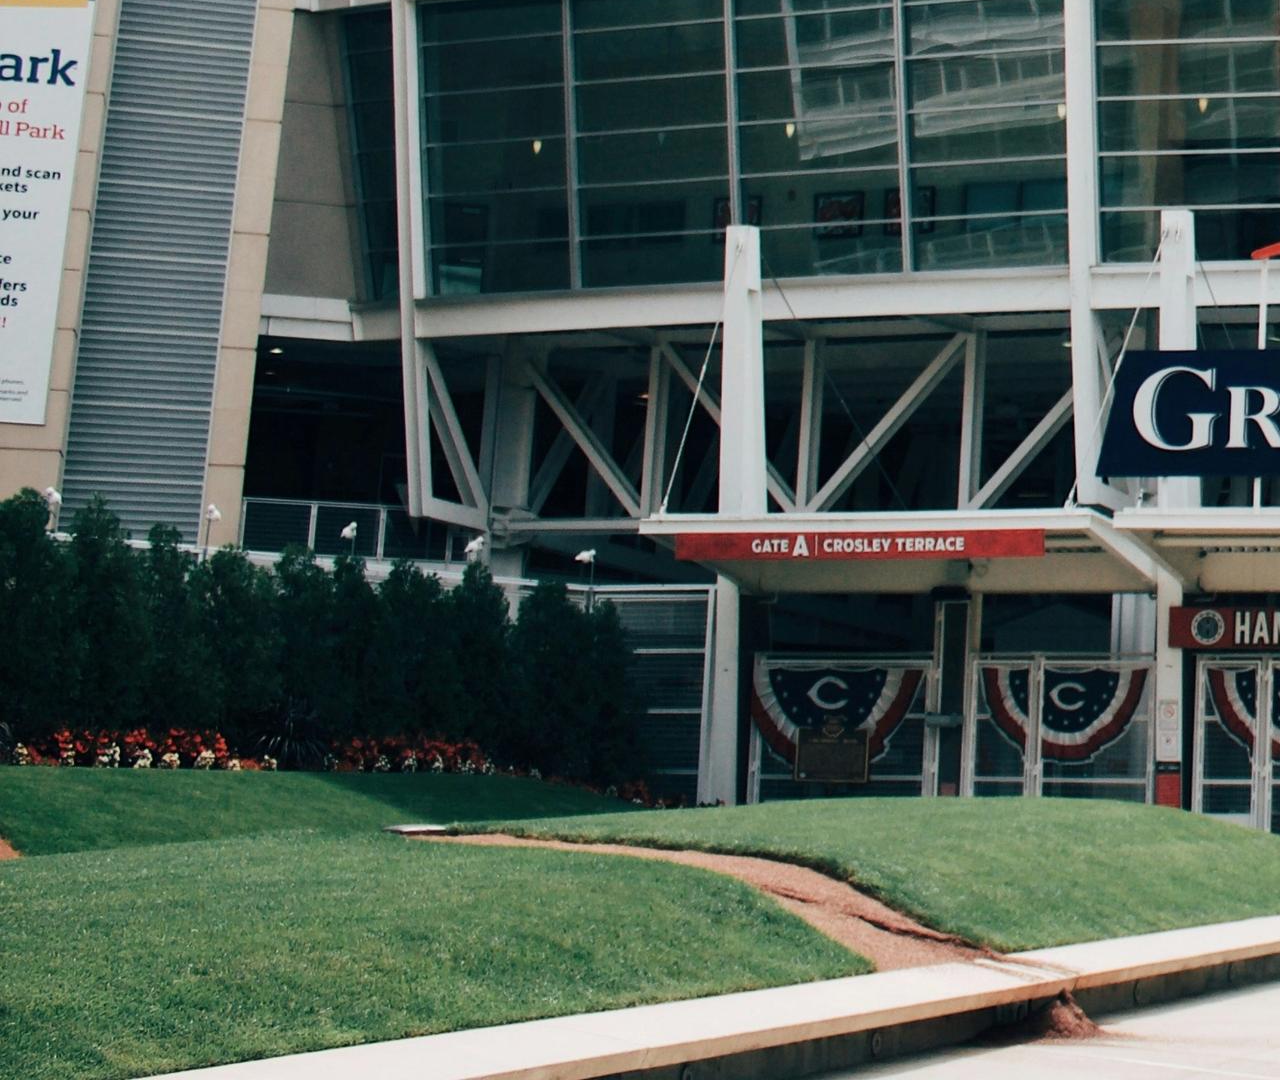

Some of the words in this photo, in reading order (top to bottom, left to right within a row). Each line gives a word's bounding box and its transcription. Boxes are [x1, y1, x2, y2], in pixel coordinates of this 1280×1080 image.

[8, 98, 29, 114] of
[15, 122, 65, 140] Park
[26, 169, 61, 180] scan
[3, 208, 40, 221] your
[752, 538, 790, 554] GATE
[792, 534, 809, 557] A
[823, 537, 891, 554] CROSLEY
[896, 536, 965, 553] TERRACE
